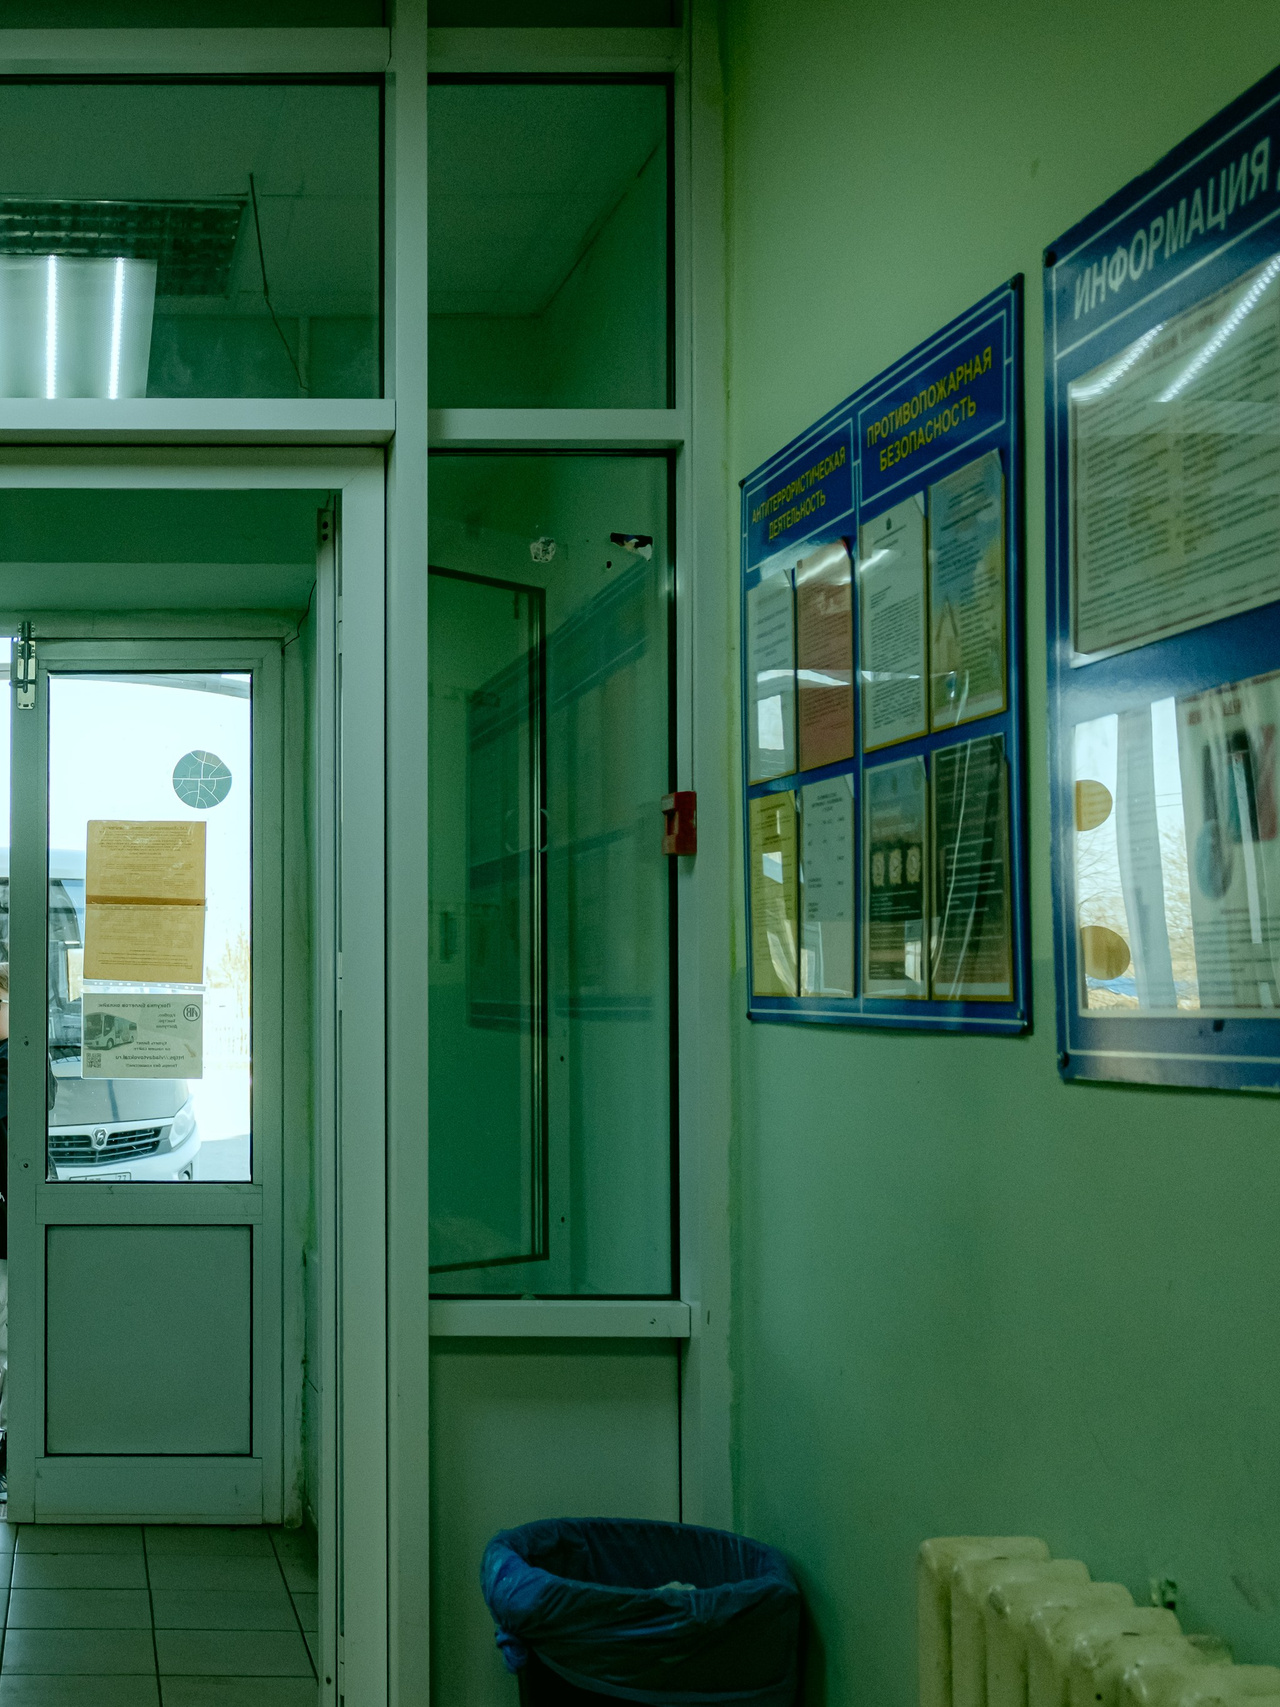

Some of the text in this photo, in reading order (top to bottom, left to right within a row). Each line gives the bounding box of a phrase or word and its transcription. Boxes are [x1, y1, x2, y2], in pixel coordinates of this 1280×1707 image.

[1074, 136, 1271, 320] ИНФОРМАЦИЯ
[867, 346, 993, 448] ПРОТИВОПОЖАРНАЯ
[879, 395, 977, 472] БЕЗОПАСНОСТЬ
[752, 446, 846, 525] АНТИТЕРРОРИСТИЧЕСКАЯ
[768, 489, 827, 540] ДЕЯТЕЛЬНОСТЬ
